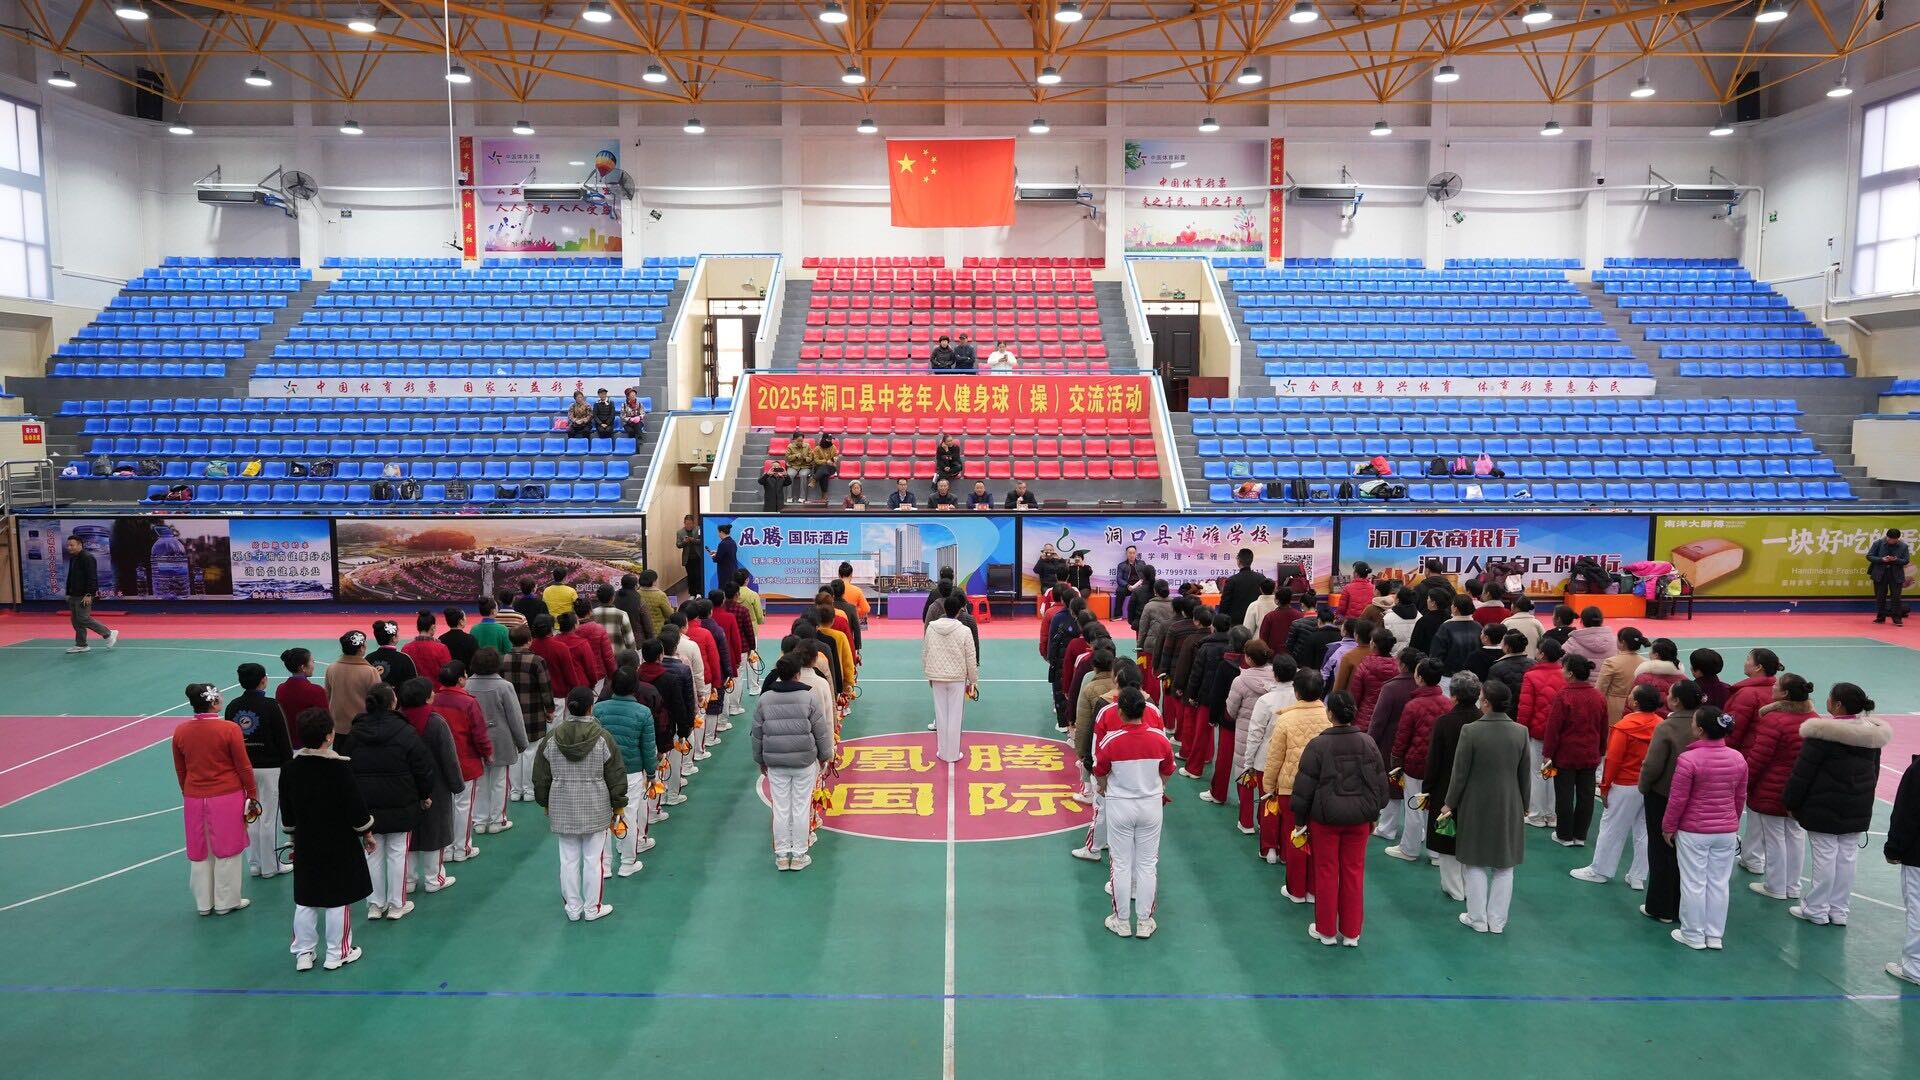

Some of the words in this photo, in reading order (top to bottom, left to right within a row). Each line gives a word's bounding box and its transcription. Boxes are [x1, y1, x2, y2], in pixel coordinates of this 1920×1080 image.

[1159, 177, 1229, 189] 中国体育彩票
[496, 203, 551, 216] 人人参与
[316, 380, 438, 394] 中国体育彩票
[463, 380, 585, 394] 国家公益彩票
[1308, 379, 1453, 394] 全民健身兴体育
[1478, 379, 1622, 394] 体育彩票惠全民
[757, 383, 1143, 414] 2025年洞口县中老年人健身球（操）交流活动
[788, 530, 849, 545] 国际酒店
[1104, 524, 1270, 546] 洞口县博雅学校
[1368, 528, 1520, 549] 洞口农商银行
[825, 782, 1083, 817] 国际
